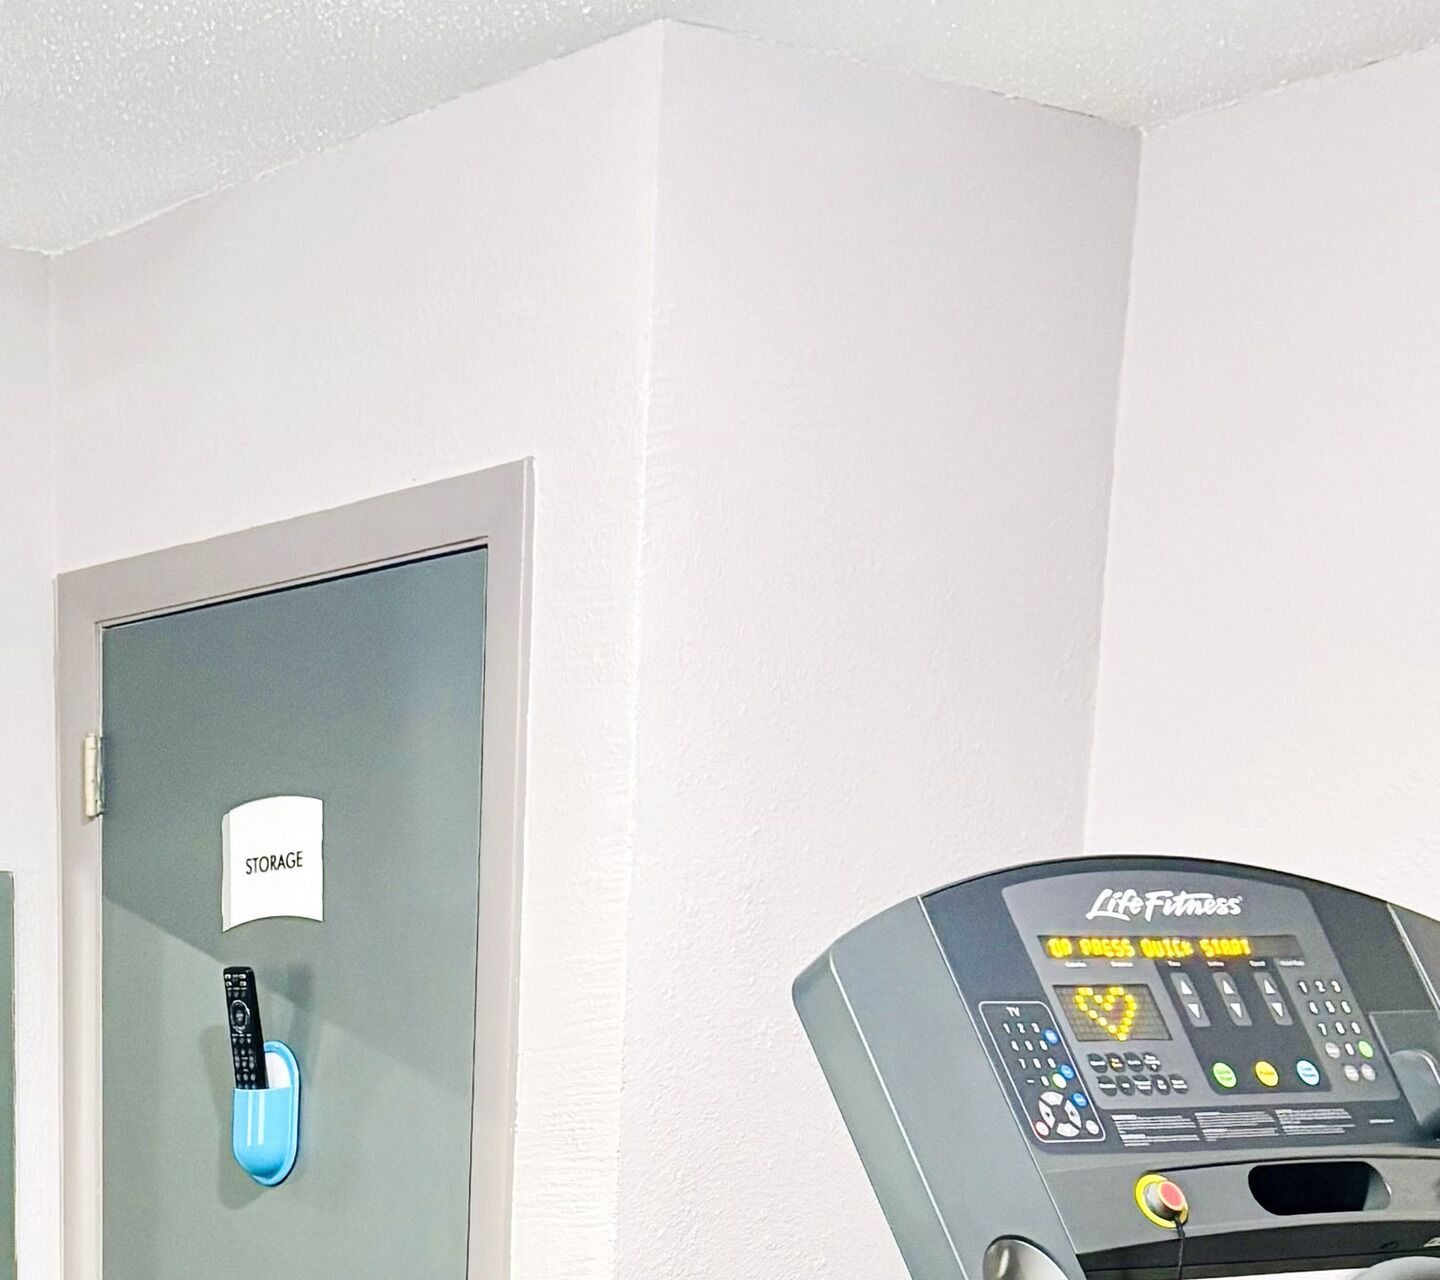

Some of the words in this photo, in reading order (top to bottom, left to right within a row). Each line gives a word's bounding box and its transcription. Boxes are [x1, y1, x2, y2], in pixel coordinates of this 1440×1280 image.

[245, 851, 303, 875] STORAGE
[1085, 888, 1144, 922] Life
[1144, 890, 1242, 923] Fitness
[1199, 938, 1252, 958] START
